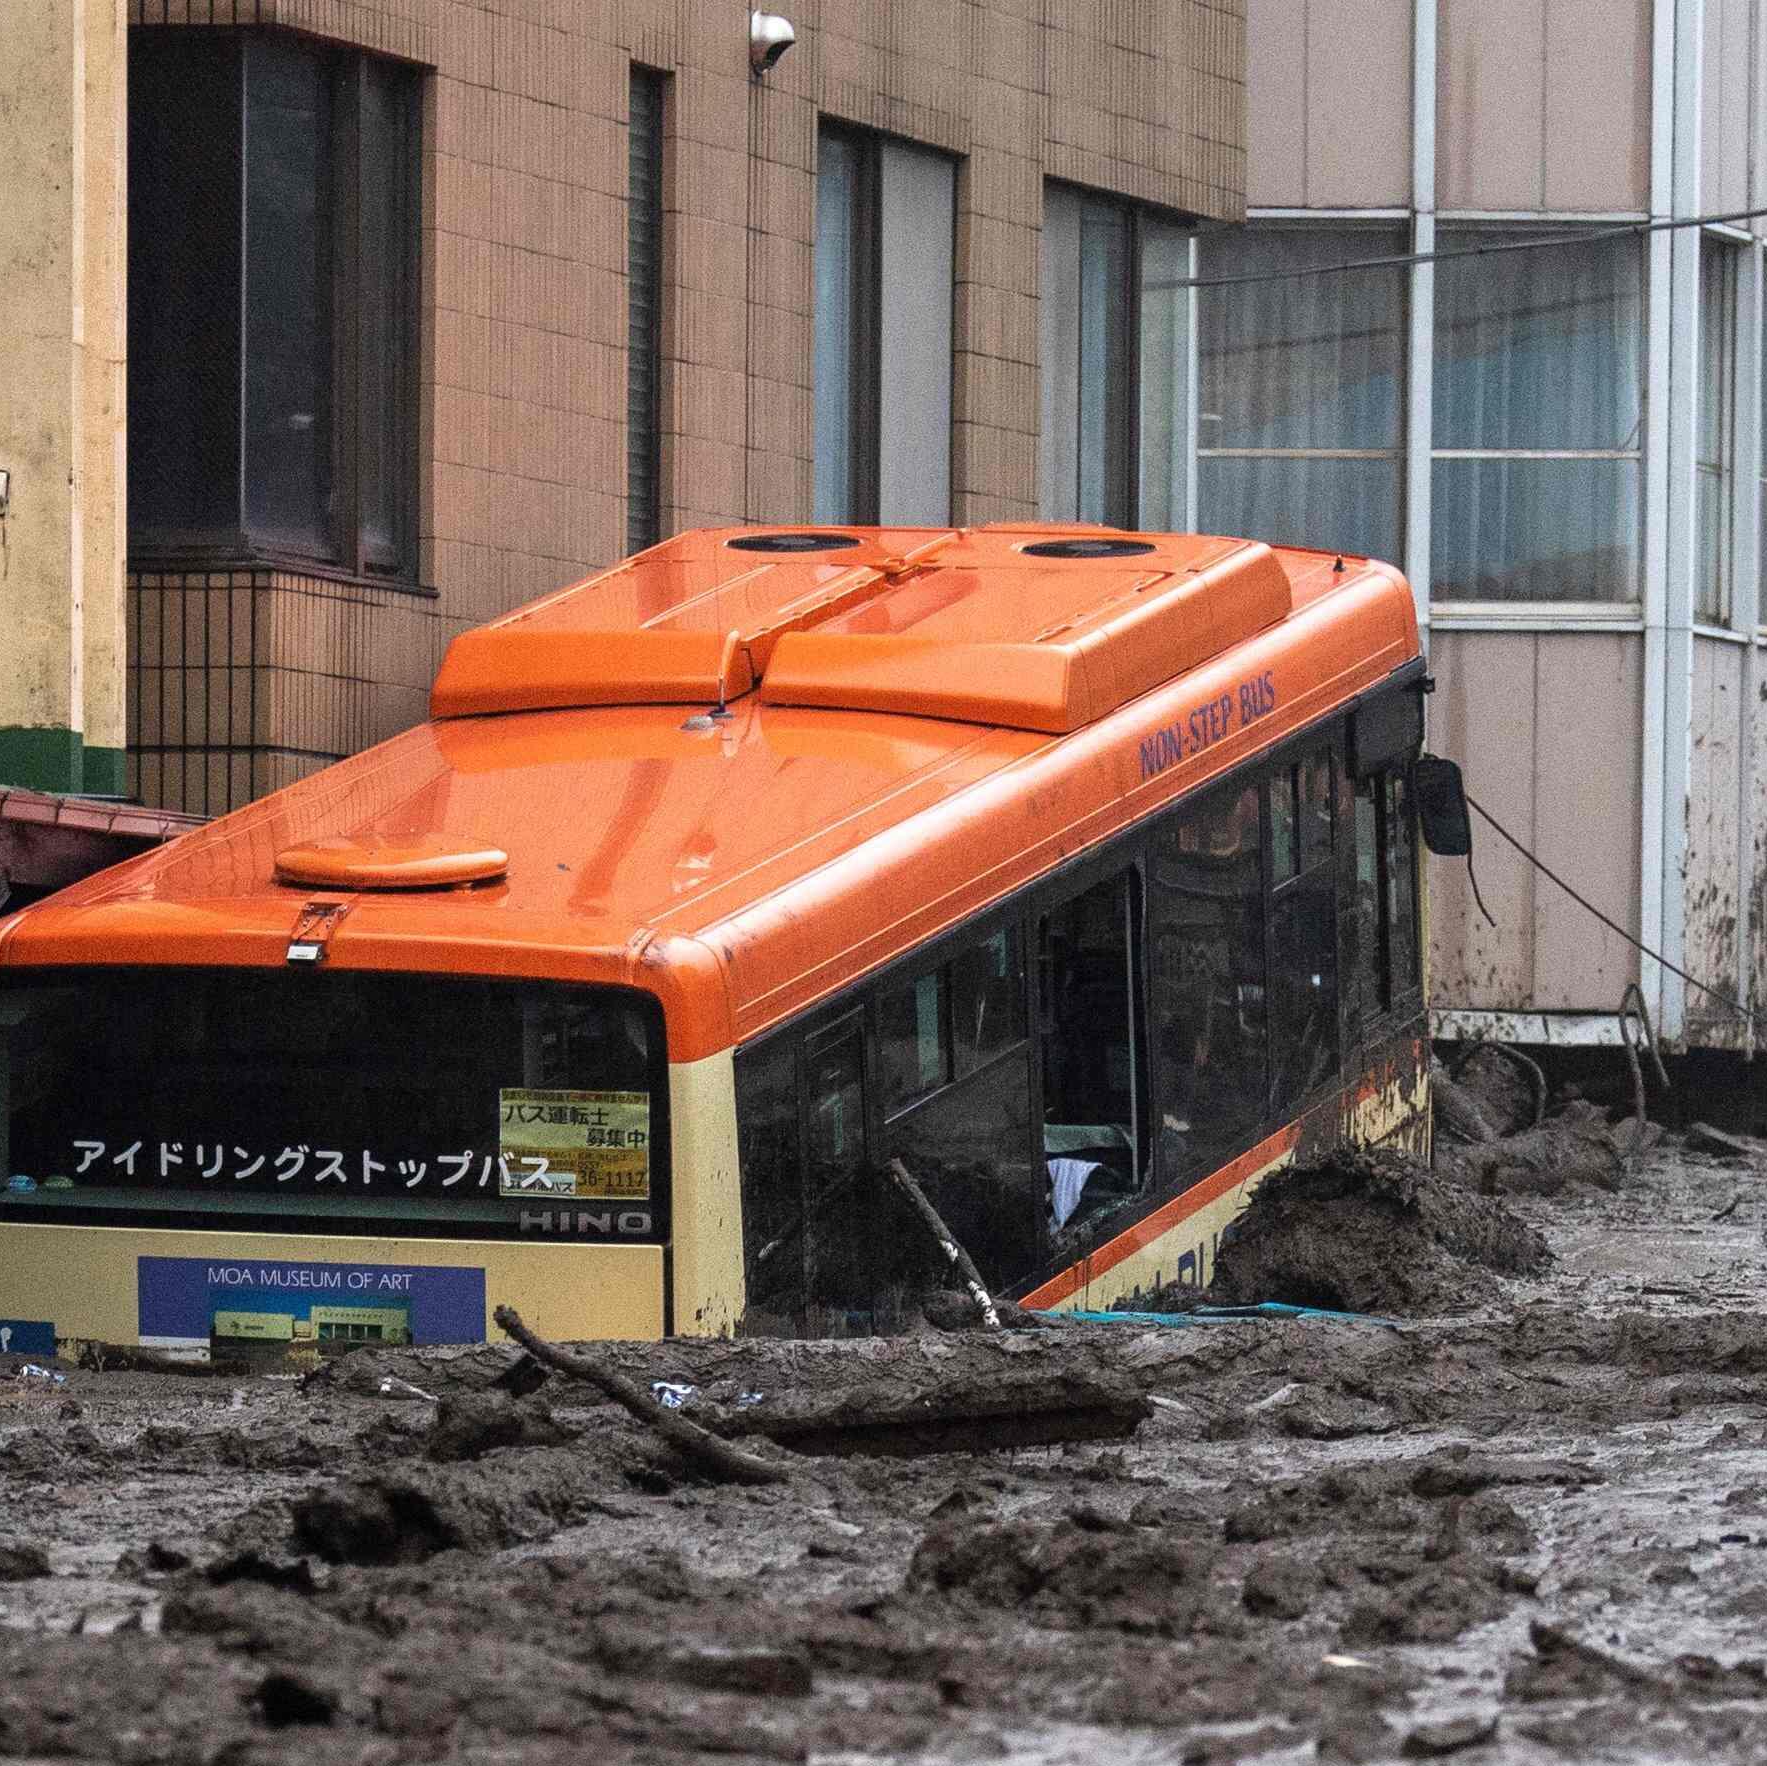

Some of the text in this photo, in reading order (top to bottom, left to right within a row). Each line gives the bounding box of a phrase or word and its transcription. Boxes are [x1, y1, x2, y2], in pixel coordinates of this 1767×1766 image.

[1139, 670, 1276, 782] NON-STEP BUS
[504, 1104, 610, 1127] バス運転士
[585, 1127, 646, 1149] 募集中
[72, 1139, 553, 1188] アイドリングストップバス
[519, 1210, 652, 1234] HINO
[207, 1267, 413, 1291] MOA MUSEUM OF ART
